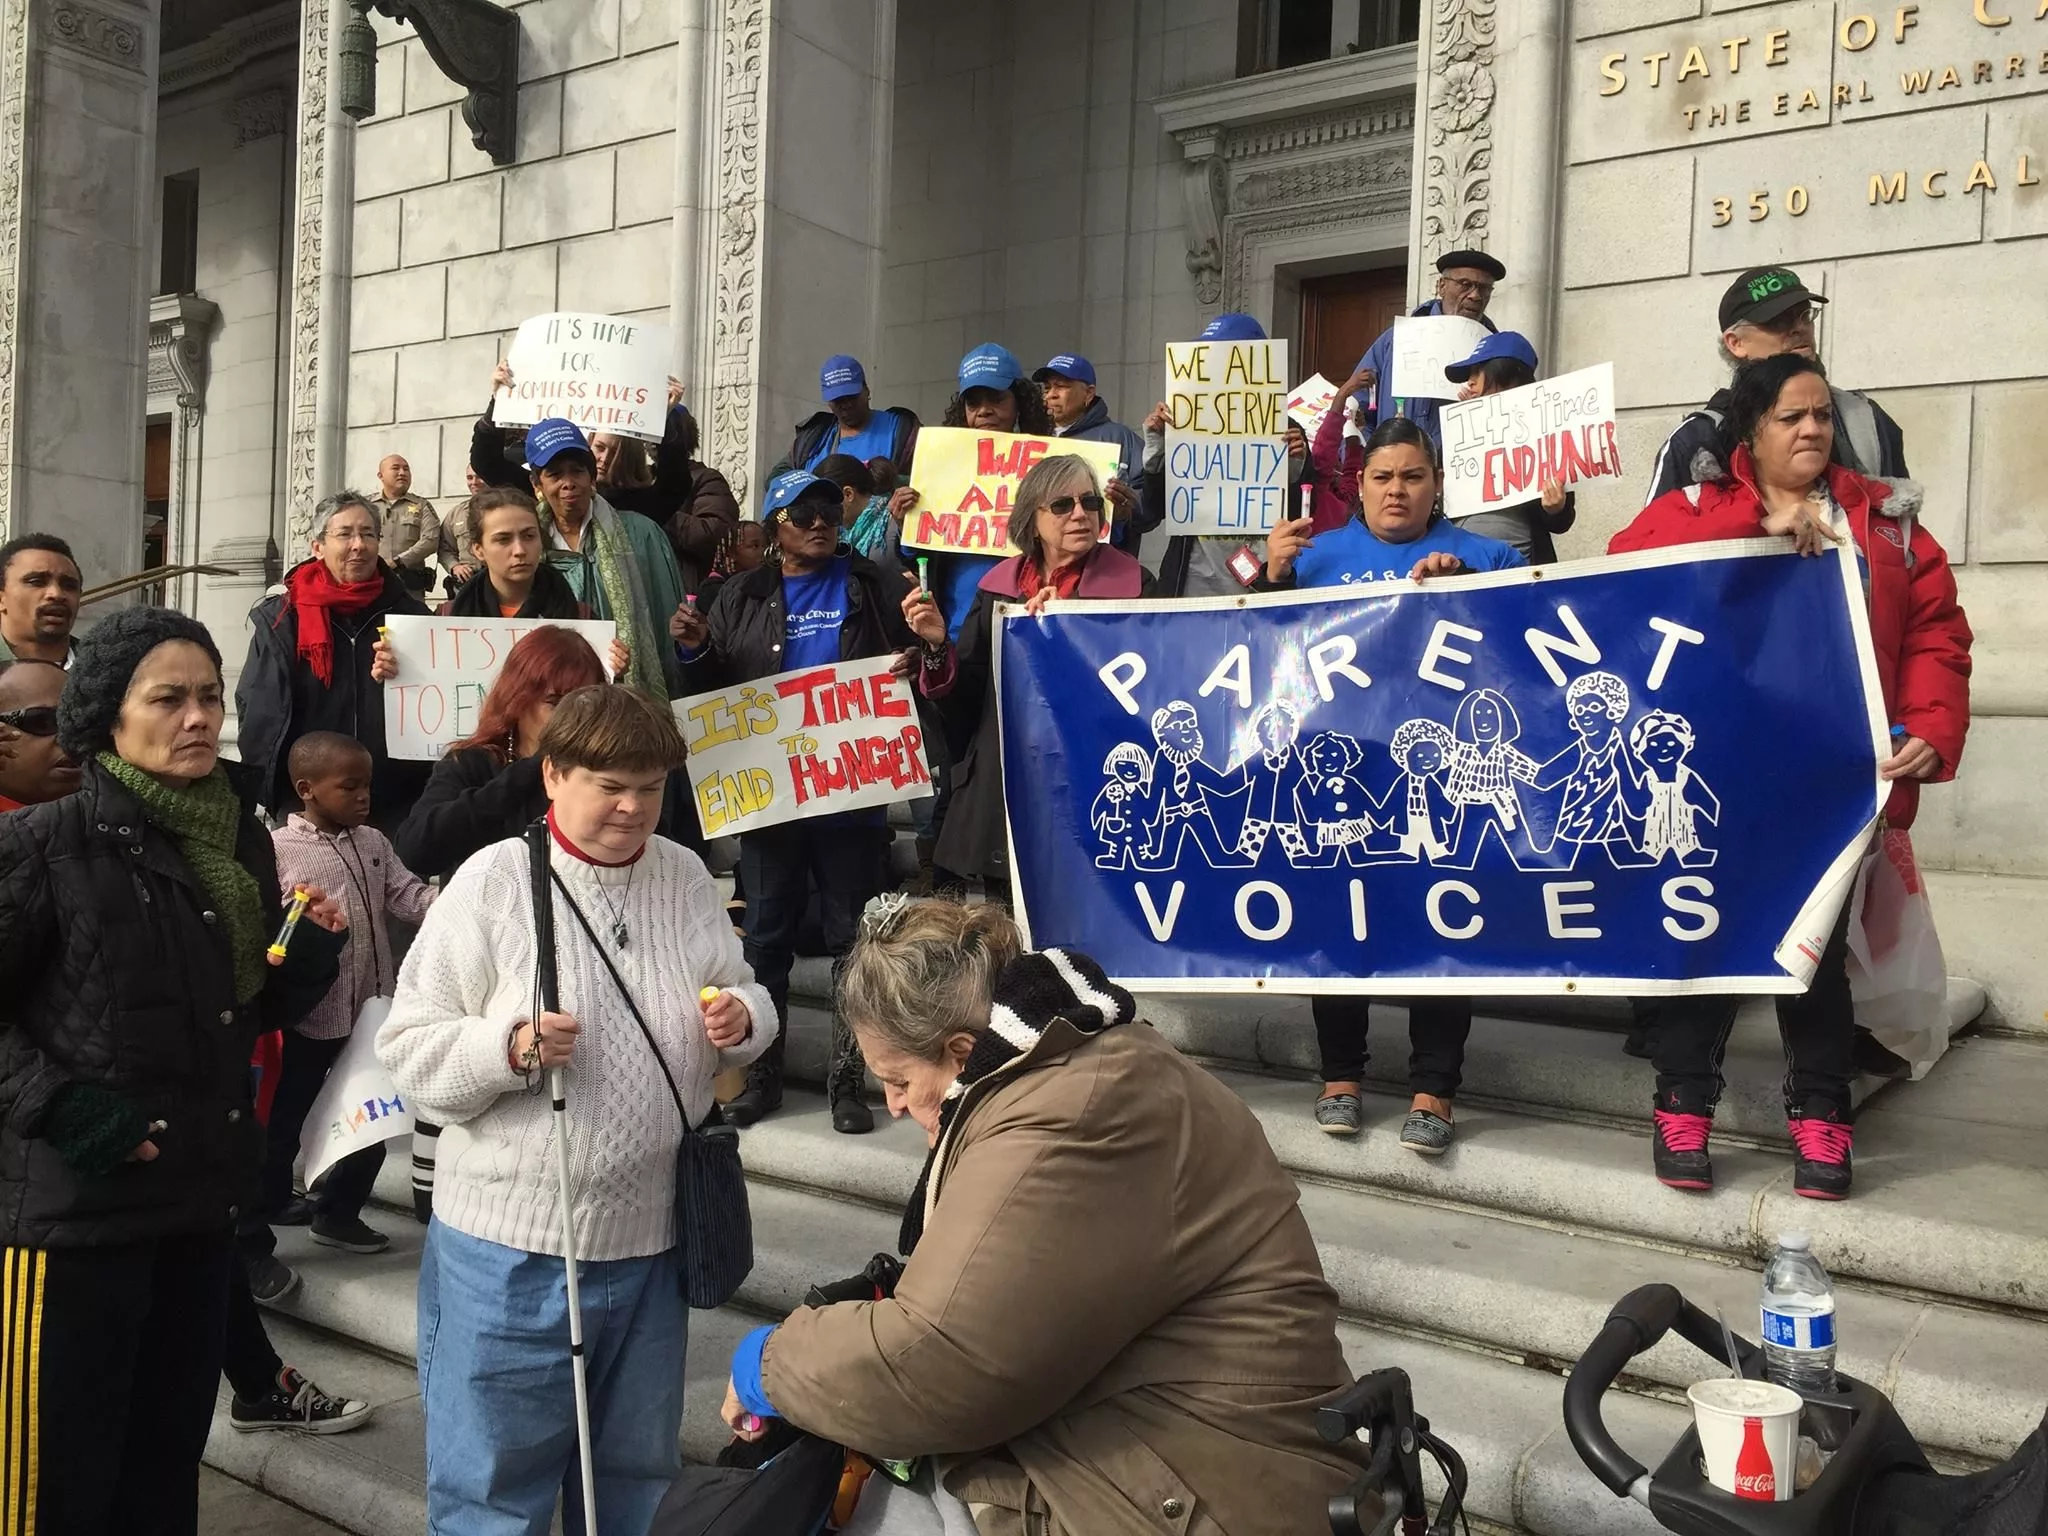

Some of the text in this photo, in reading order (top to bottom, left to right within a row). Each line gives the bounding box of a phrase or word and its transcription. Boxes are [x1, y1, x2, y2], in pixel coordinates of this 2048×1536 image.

[1599, 28, 1788, 96] STATE
[1839, 3, 1918, 52] OF
[1683, 100, 1751, 131] THE
[1773, 80, 1874, 116] EARL
[1711, 185, 1809, 228] 350
[545, 318, 639, 347] IT'S TIME
[1168, 344, 1282, 385] WE ALL
[567, 404, 645, 427] MATTER
[596, 383, 649, 404] LIVES
[1172, 391, 1288, 436] DESERVE
[1446, 385, 1600, 453] It's time
[977, 437, 1050, 481] WE
[1170, 442, 1288, 484] QUALITY
[1451, 420, 1623, 502] to END HUNGER
[957, 484, 1017, 513] AL
[1171, 486, 1204, 524] OF
[429, 628, 496, 670] IT'S
[1098, 604, 1704, 716] PARENT
[390, 683, 445, 737] TO
[687, 668, 912, 756] IT'S TIME
[778, 733, 819, 755] TO
[695, 767, 775, 835] END
[1134, 876, 1720, 942] VOICES
